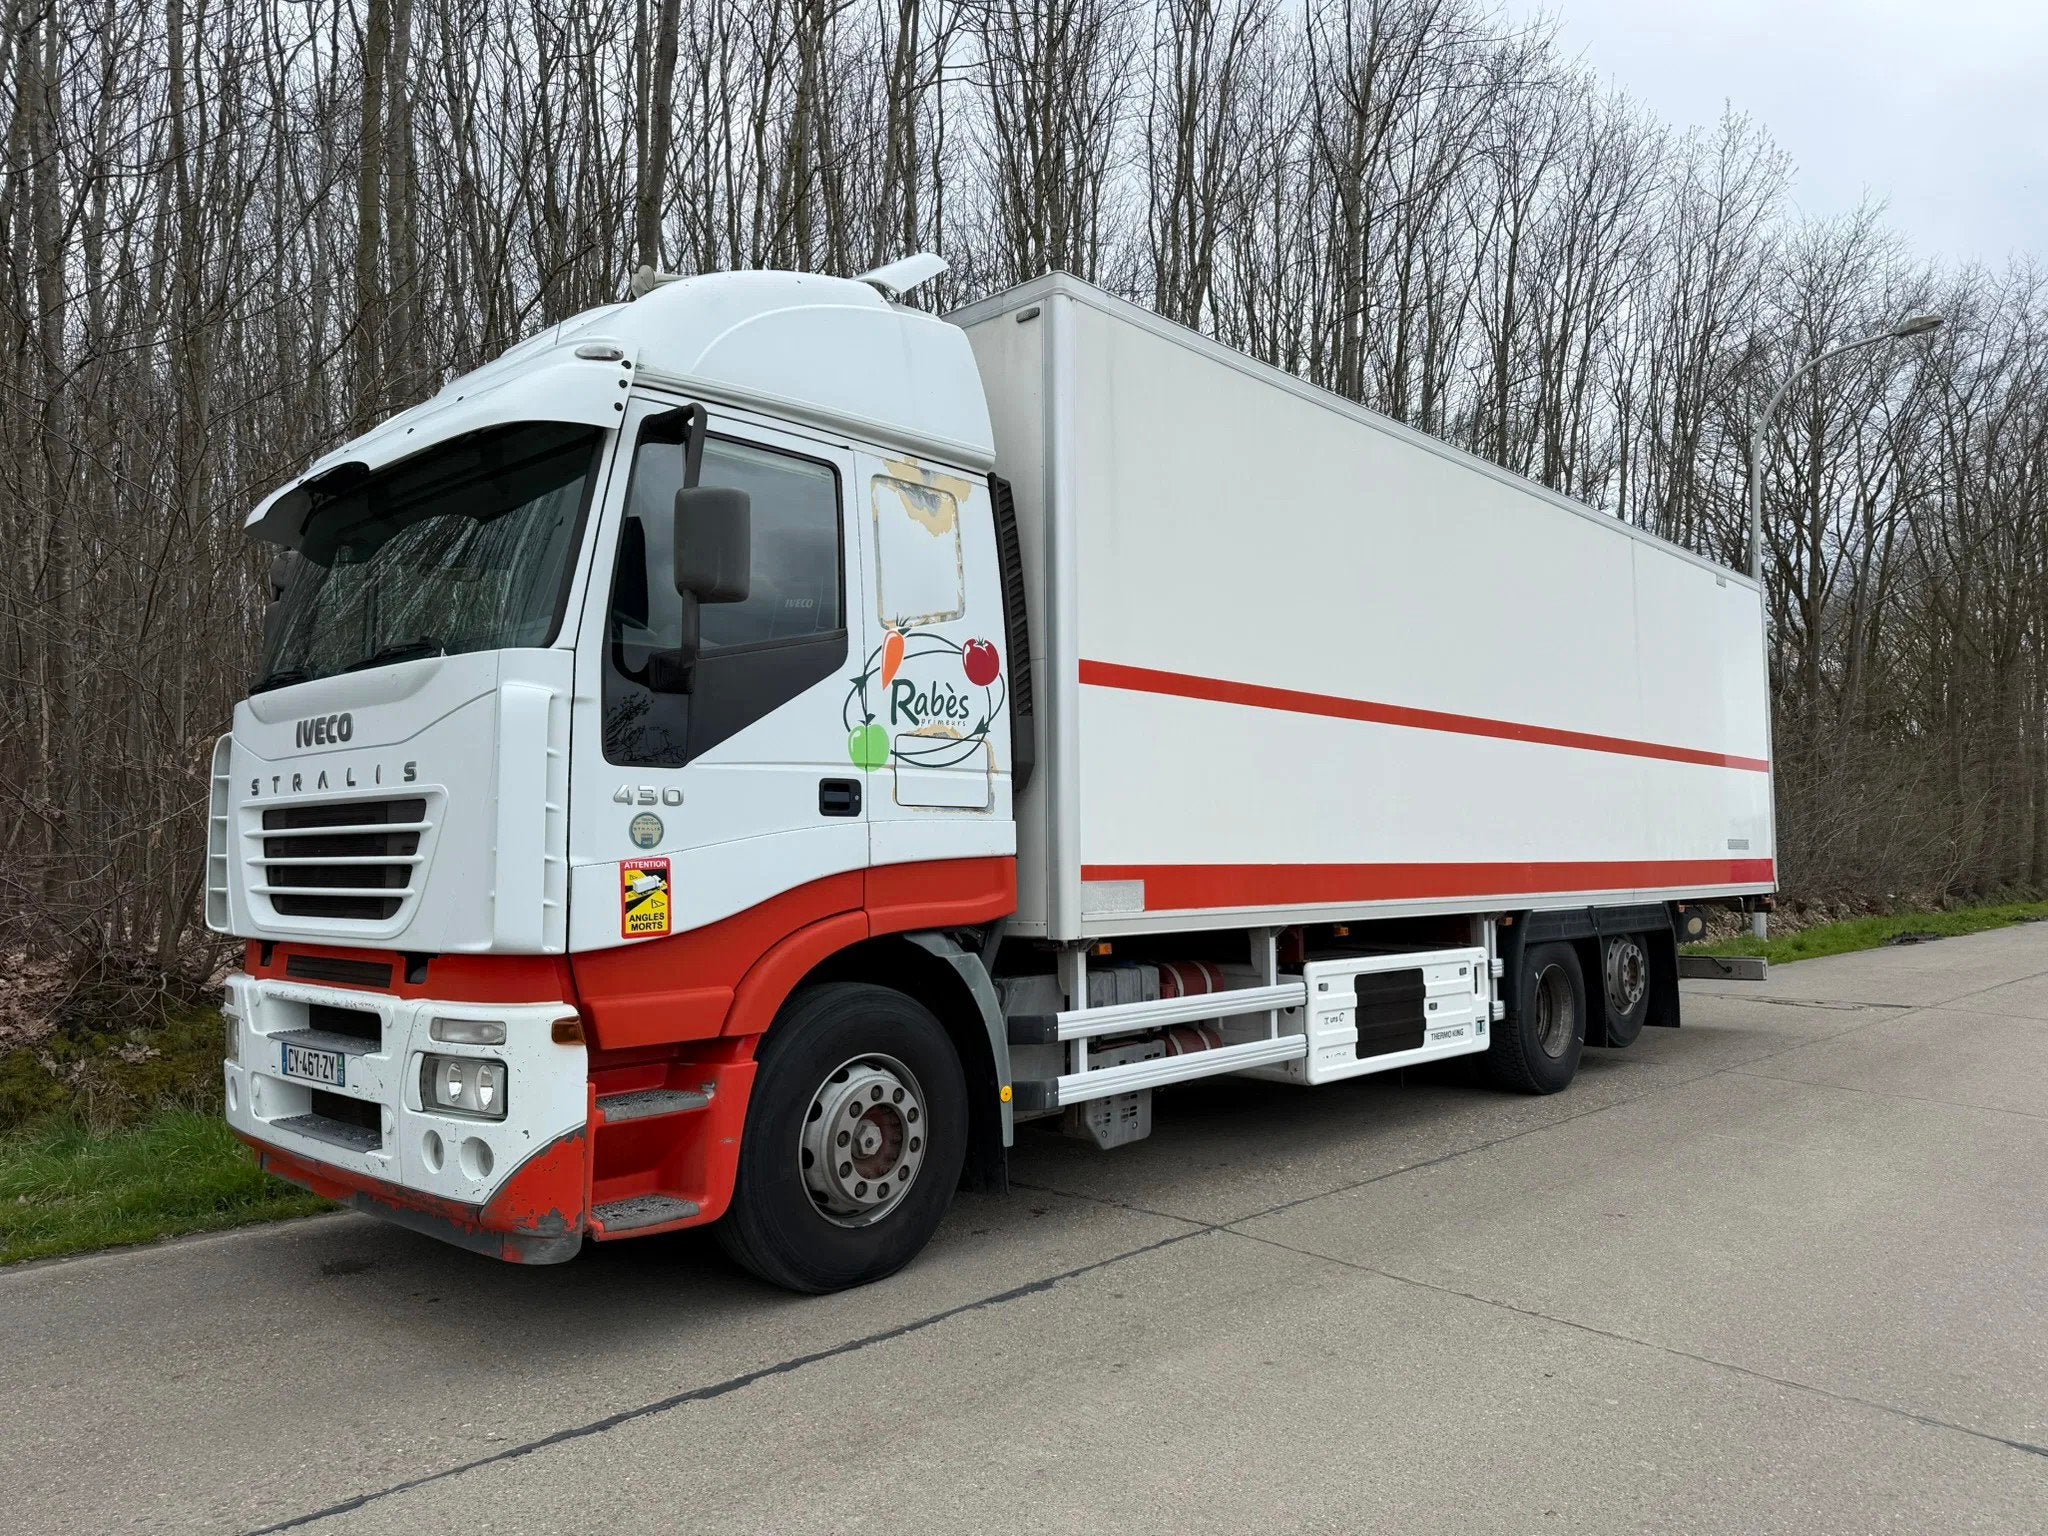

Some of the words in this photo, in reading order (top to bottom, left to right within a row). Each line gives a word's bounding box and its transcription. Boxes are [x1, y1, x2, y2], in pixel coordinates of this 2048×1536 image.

[784, 598, 814, 609] IVECO
[890, 678, 970, 726] Rabès
[296, 712, 354, 748] IVECO
[251, 761, 417, 797] STRALIS
[613, 784, 685, 807] 430
[624, 860, 667, 869] ATTENTION
[629, 912, 665, 922] ANGLES
[631, 921, 663, 931] MORTS
[1431, 1030, 1451, 1041] THERMO
[288, 1048, 335, 1080] CY-467-ZY
